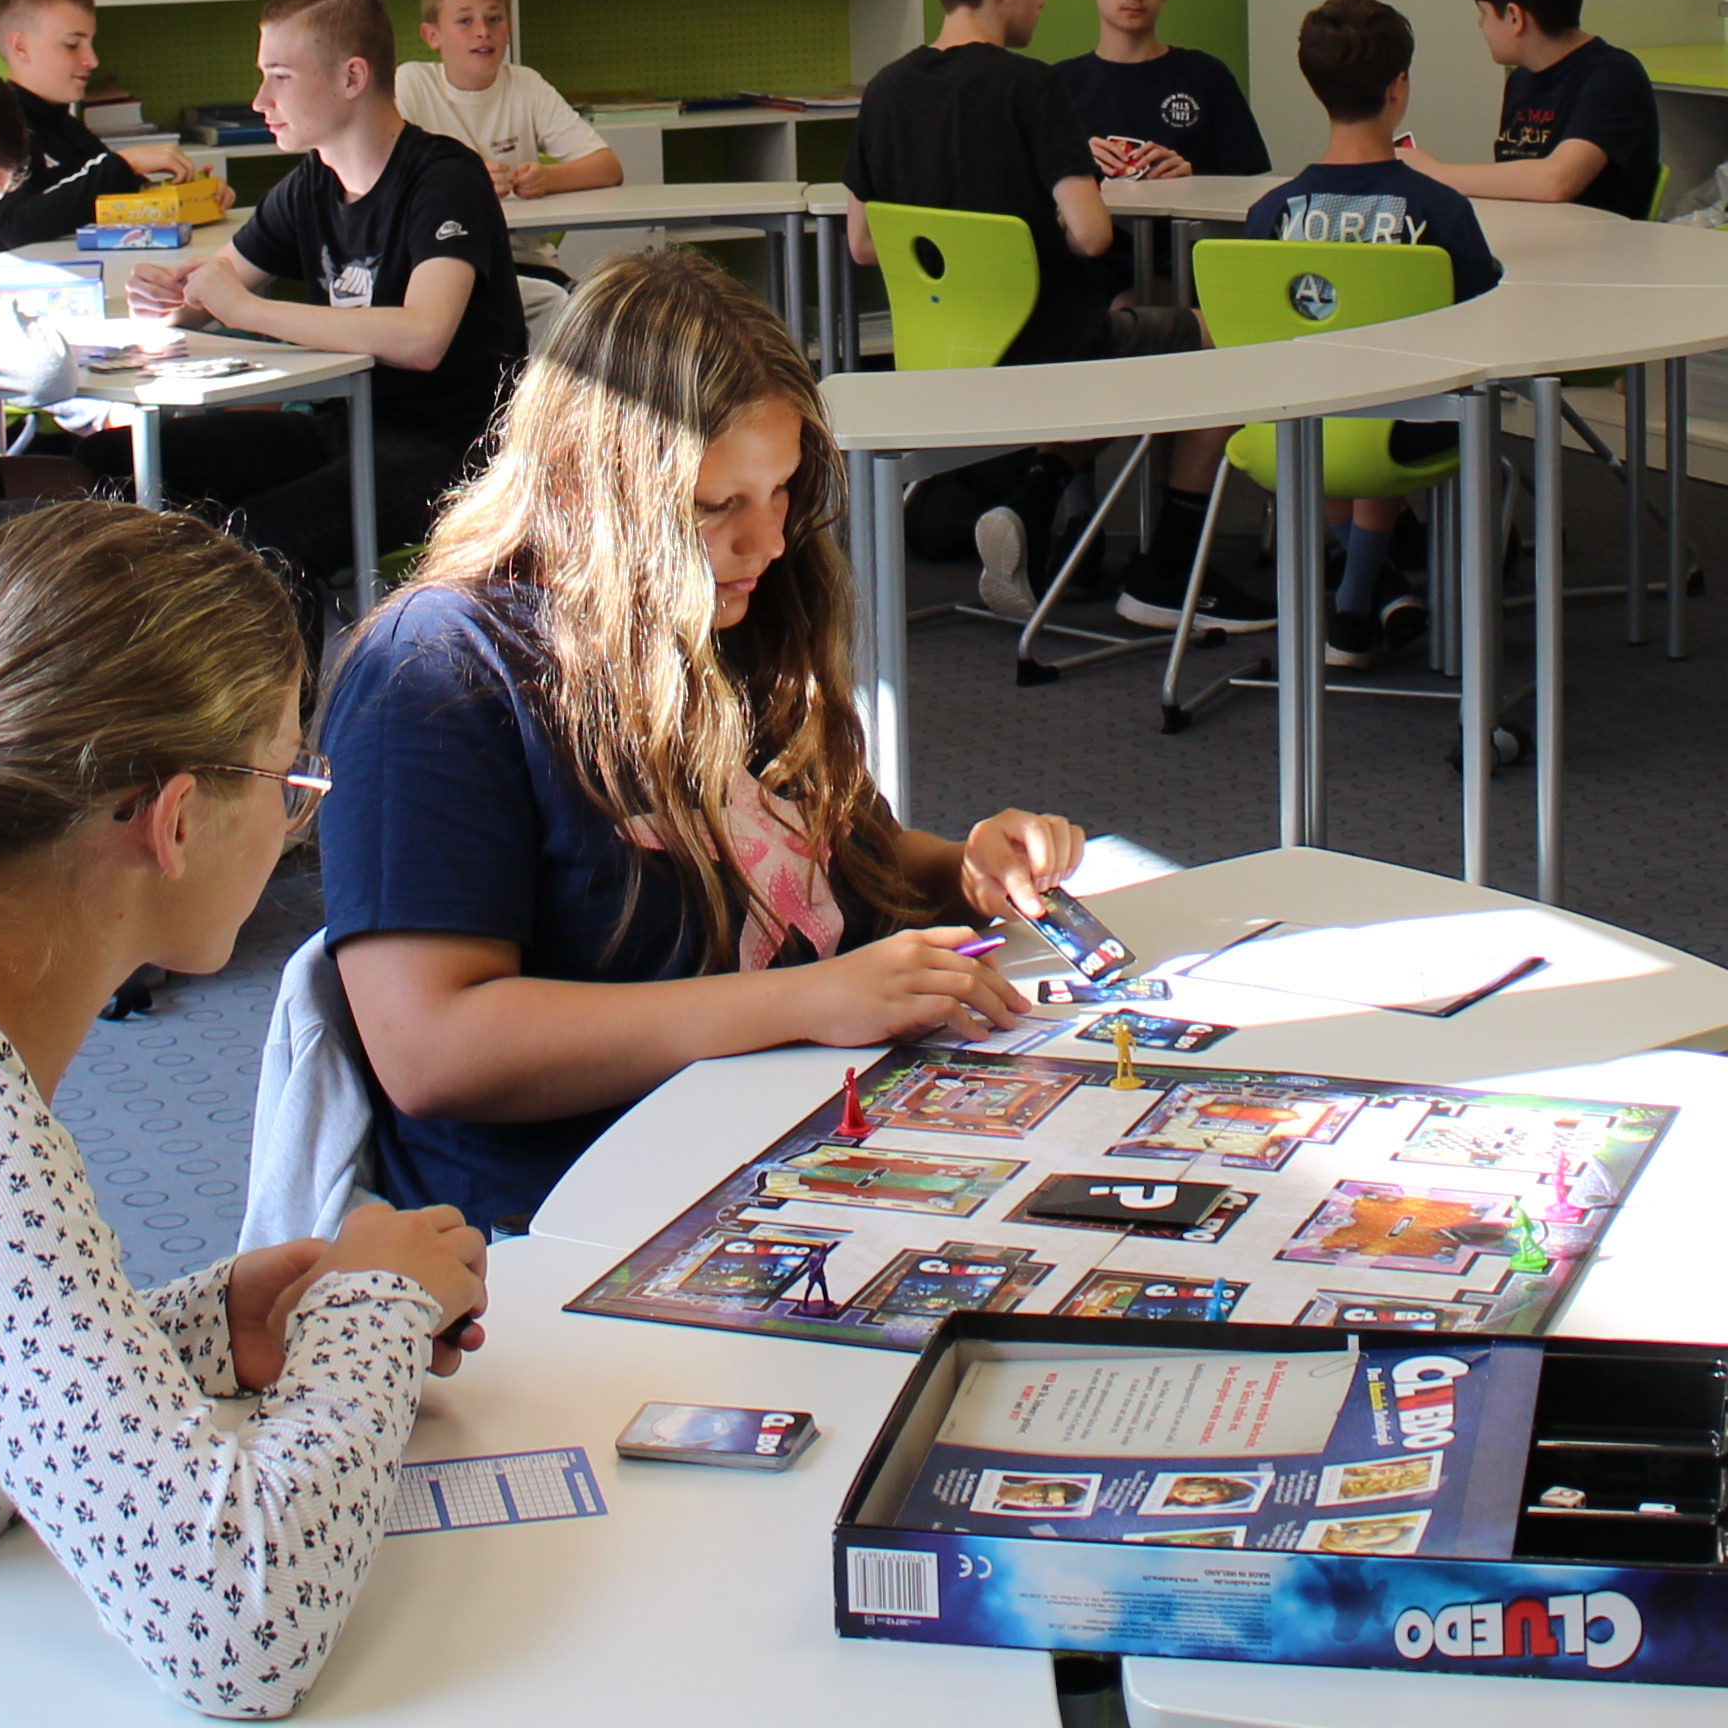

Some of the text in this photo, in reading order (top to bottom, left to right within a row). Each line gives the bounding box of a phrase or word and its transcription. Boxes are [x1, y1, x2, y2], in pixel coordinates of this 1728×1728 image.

[724, 1240, 812, 1256] CLUEDO
[918, 1258, 1008, 1276] CLUEDO
[1342, 1307, 1437, 1323] CLUEDO
[1391, 1355, 1471, 1451] CLUEDO
[1393, 1590, 1643, 1670] CLUEDO
